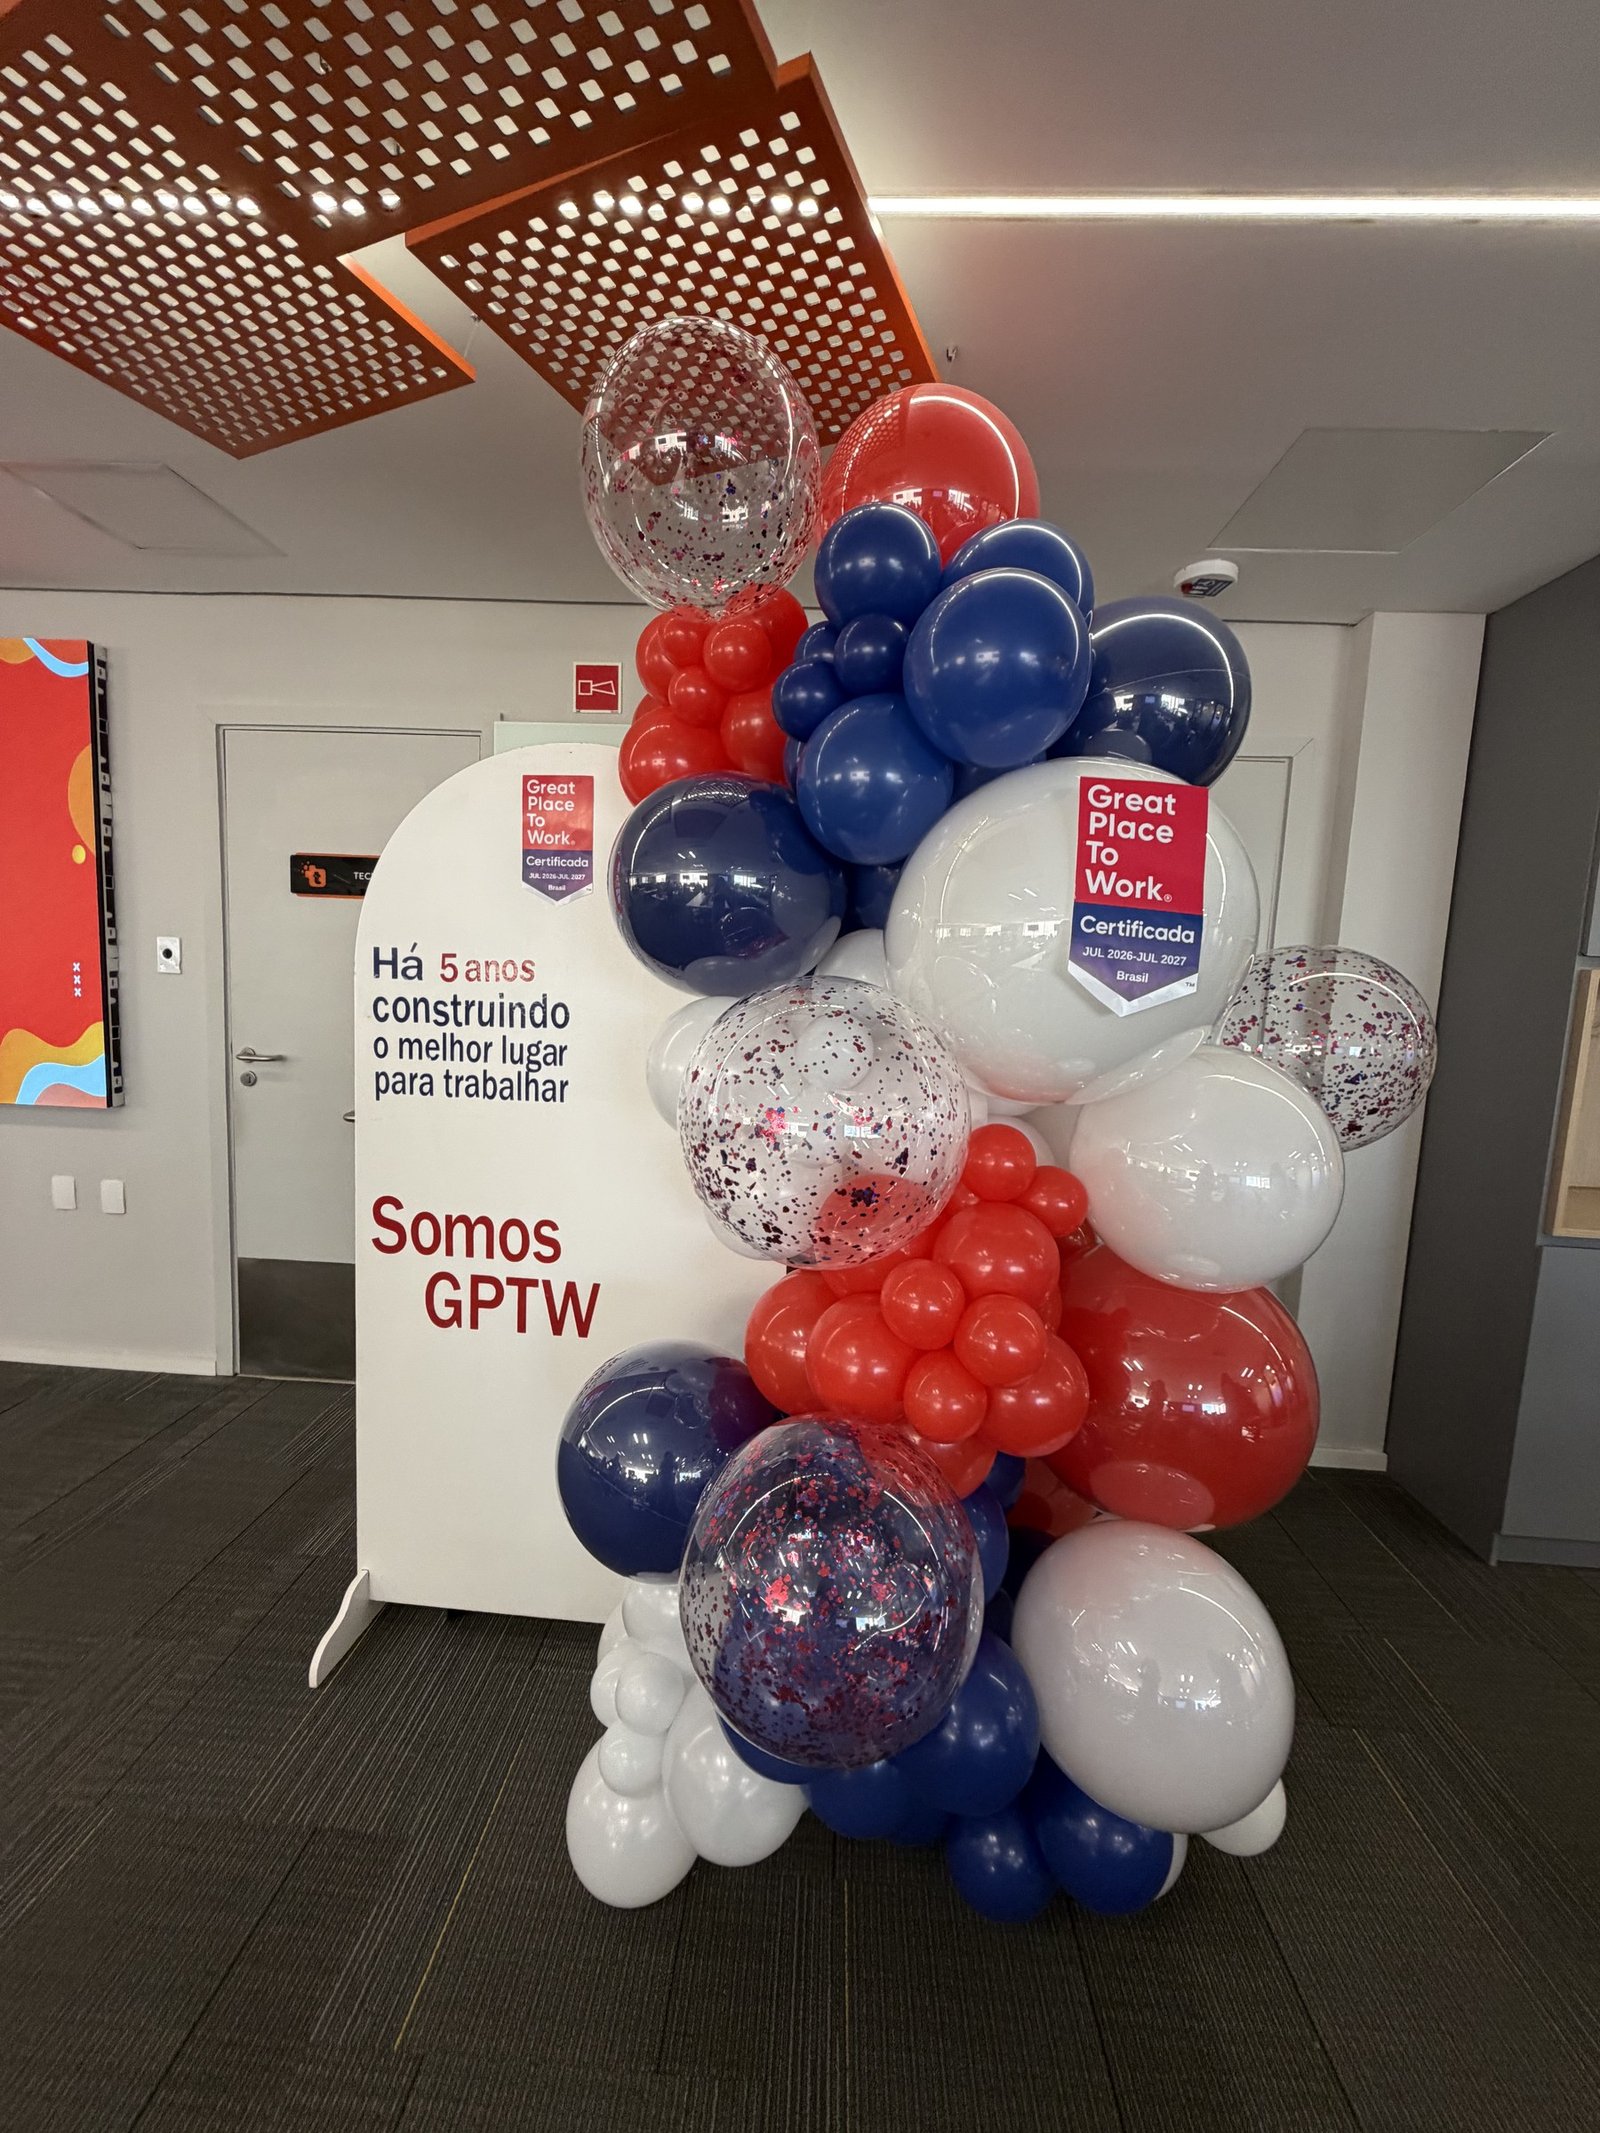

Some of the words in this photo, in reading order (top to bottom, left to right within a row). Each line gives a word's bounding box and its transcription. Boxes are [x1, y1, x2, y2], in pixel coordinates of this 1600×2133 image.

[527, 779, 575, 794] Great
[1088, 784, 1176, 816] Great
[528, 796, 575, 811] Place
[527, 813, 545, 827] To
[1089, 812, 1174, 843] Place
[526, 855, 589, 868] Certificada
[1085, 840, 1119, 866] To
[1080, 915, 1195, 944] Certificada
[373, 942, 423, 981] Há
[439, 952, 459, 983] 5
[464, 959, 536, 983] anos
[1082, 946, 1105, 958] JUL
[1161, 954, 1187, 966] 2027
[1116, 970, 1149, 983] Brasil
[372, 992, 570, 1029] construindo
[373, 1036, 388, 1059] o
[398, 1032, 493, 1063] melhor
[502, 1035, 568, 1073] lugar
[375, 1070, 434, 1101] para
[443, 1069, 569, 1103] trabalhar
[371, 1195, 562, 1264] Somos
[424, 1271, 601, 1339] GPTW
